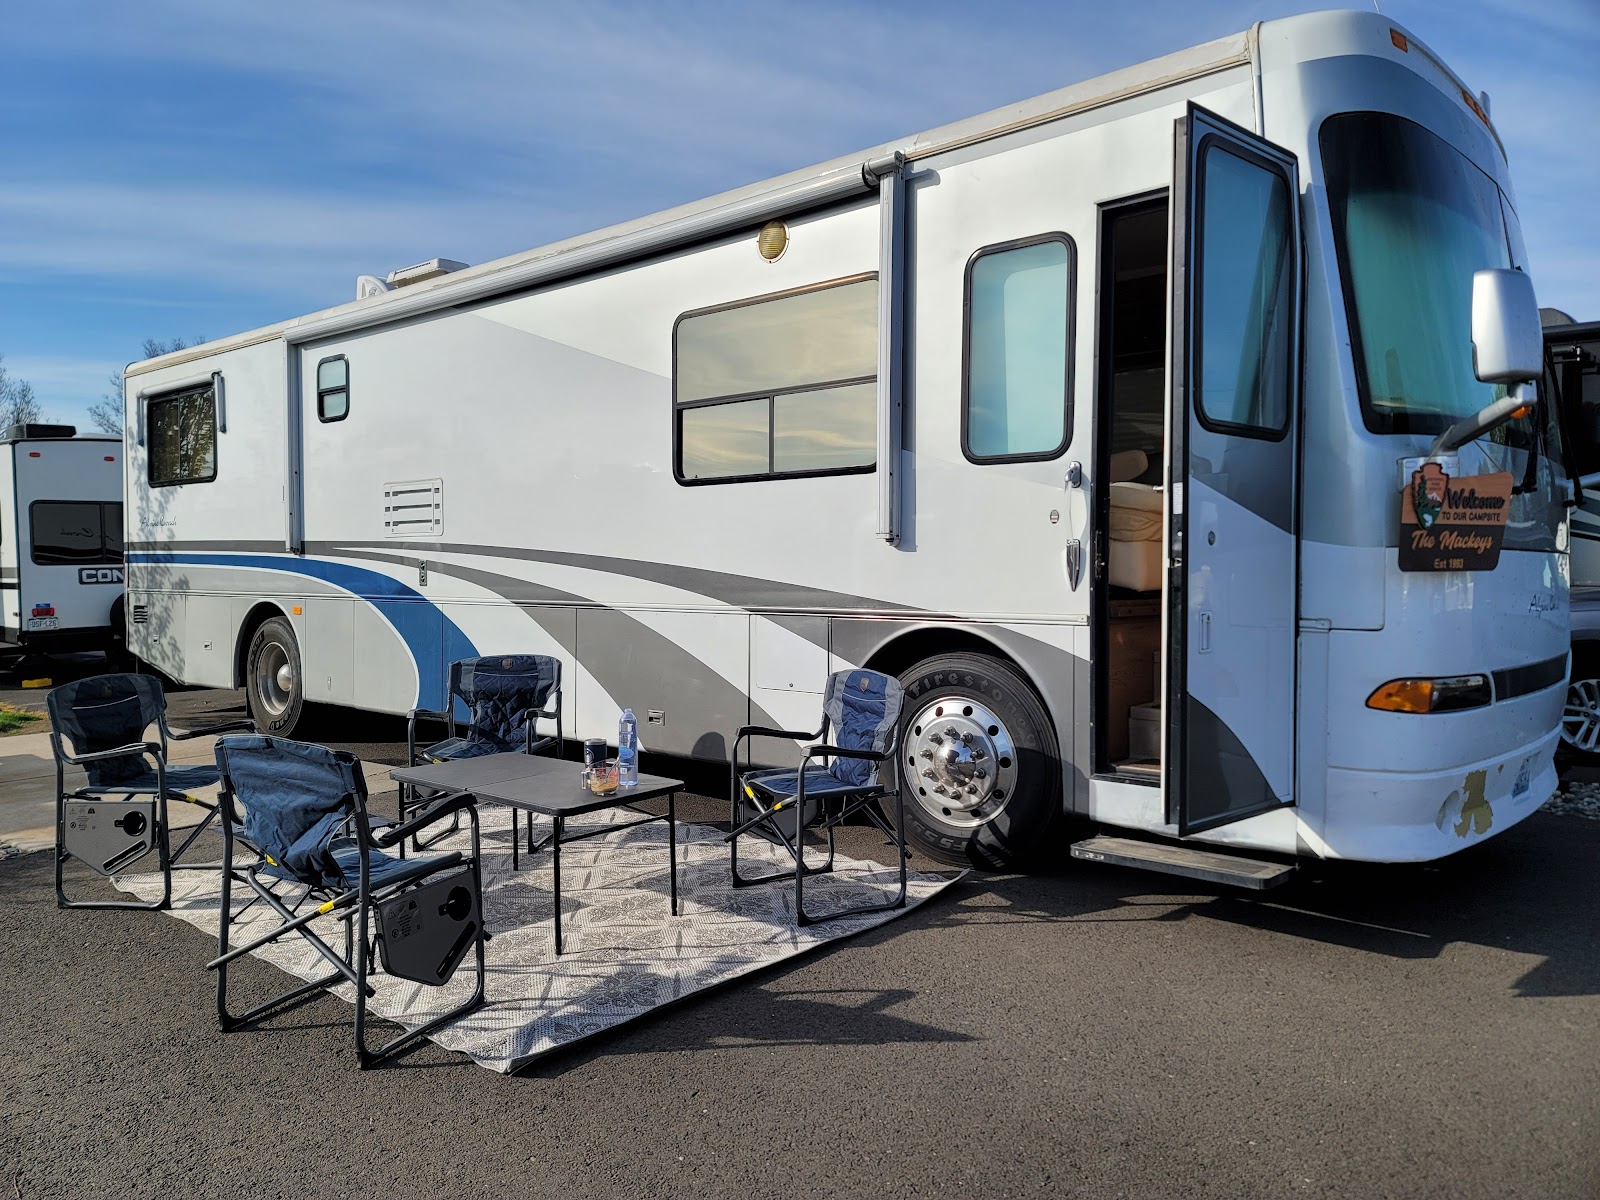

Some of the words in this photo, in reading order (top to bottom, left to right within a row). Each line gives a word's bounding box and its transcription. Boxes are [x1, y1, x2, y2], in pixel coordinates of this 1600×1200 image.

[1447, 488, 1505, 509] Welcome
[1442, 512, 1451, 520] TO
[1453, 512, 1467, 520] OUR
[1469, 512, 1501, 522] CAMPSITE
[1411, 529, 1436, 551] The
[1440, 531, 1493, 555] Mackeys
[1433, 558, 1447, 569] Est
